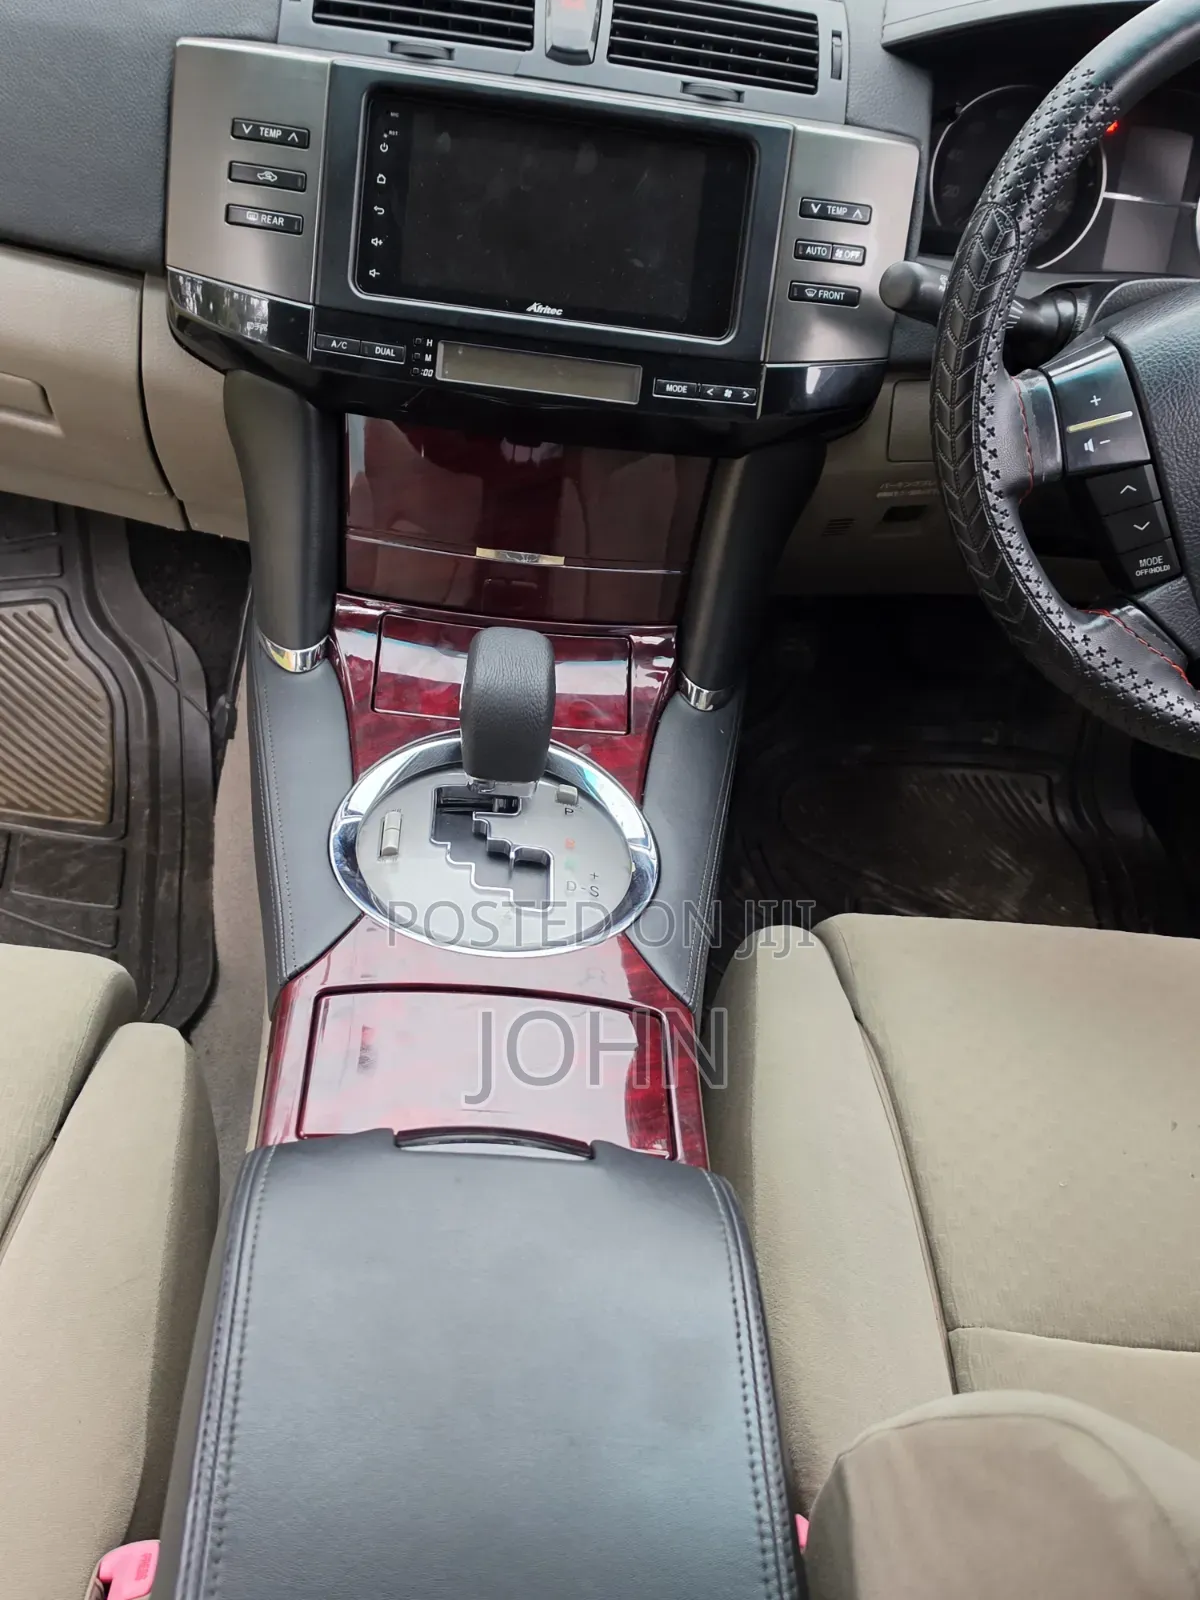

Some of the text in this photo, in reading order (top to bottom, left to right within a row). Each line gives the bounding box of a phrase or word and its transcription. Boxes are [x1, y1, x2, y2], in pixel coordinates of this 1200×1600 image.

[259, 126, 282, 139] TEMP
[827, 205, 848, 216] TEMP
[260, 214, 285, 227] REAR
[805, 245, 828, 256] AUTO
[844, 250, 861, 260] OFF
[818, 289, 845, 300] FRONT
[330, 340, 348, 350] A/C
[426, 338, 433, 347] H
[374, 346, 396, 357] DUAL
[424, 354, 432, 362] M
[665, 383, 688, 394] MODE
[1139, 555, 1164, 568] MODE
[564, 807, 574, 816] P
